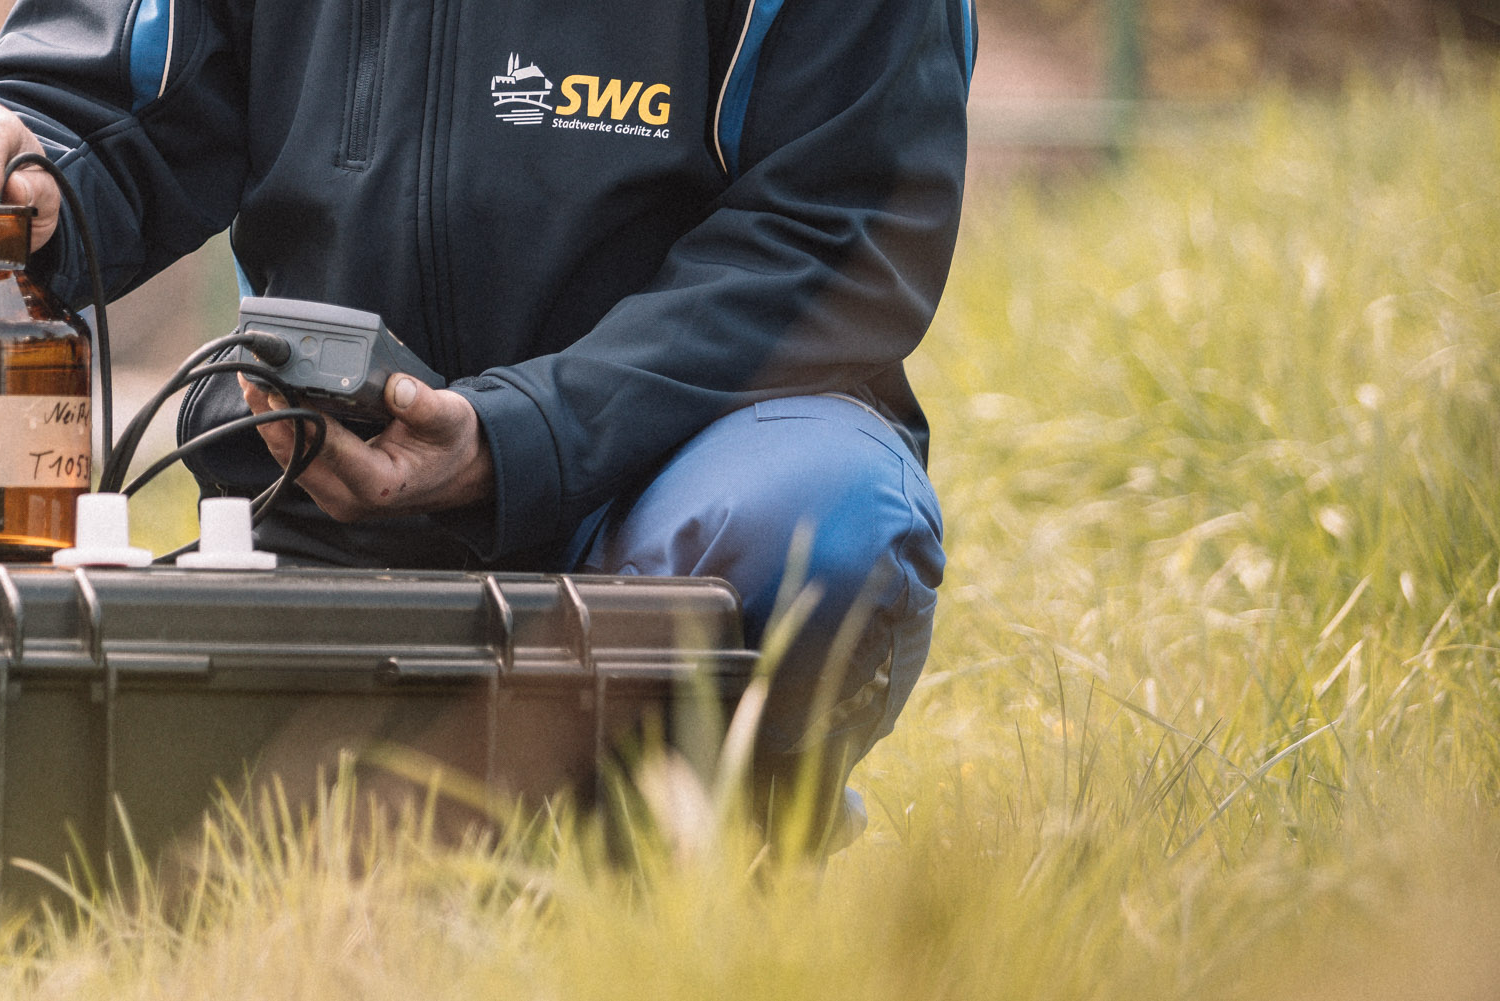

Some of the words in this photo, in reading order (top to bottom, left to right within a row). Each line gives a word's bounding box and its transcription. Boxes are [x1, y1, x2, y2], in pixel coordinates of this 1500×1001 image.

[555, 74, 671, 126] SWG
[551, 118, 612, 133] Stadtwerke
[614, 124, 651, 137] Görlitz
[653, 128, 670, 139] AG
